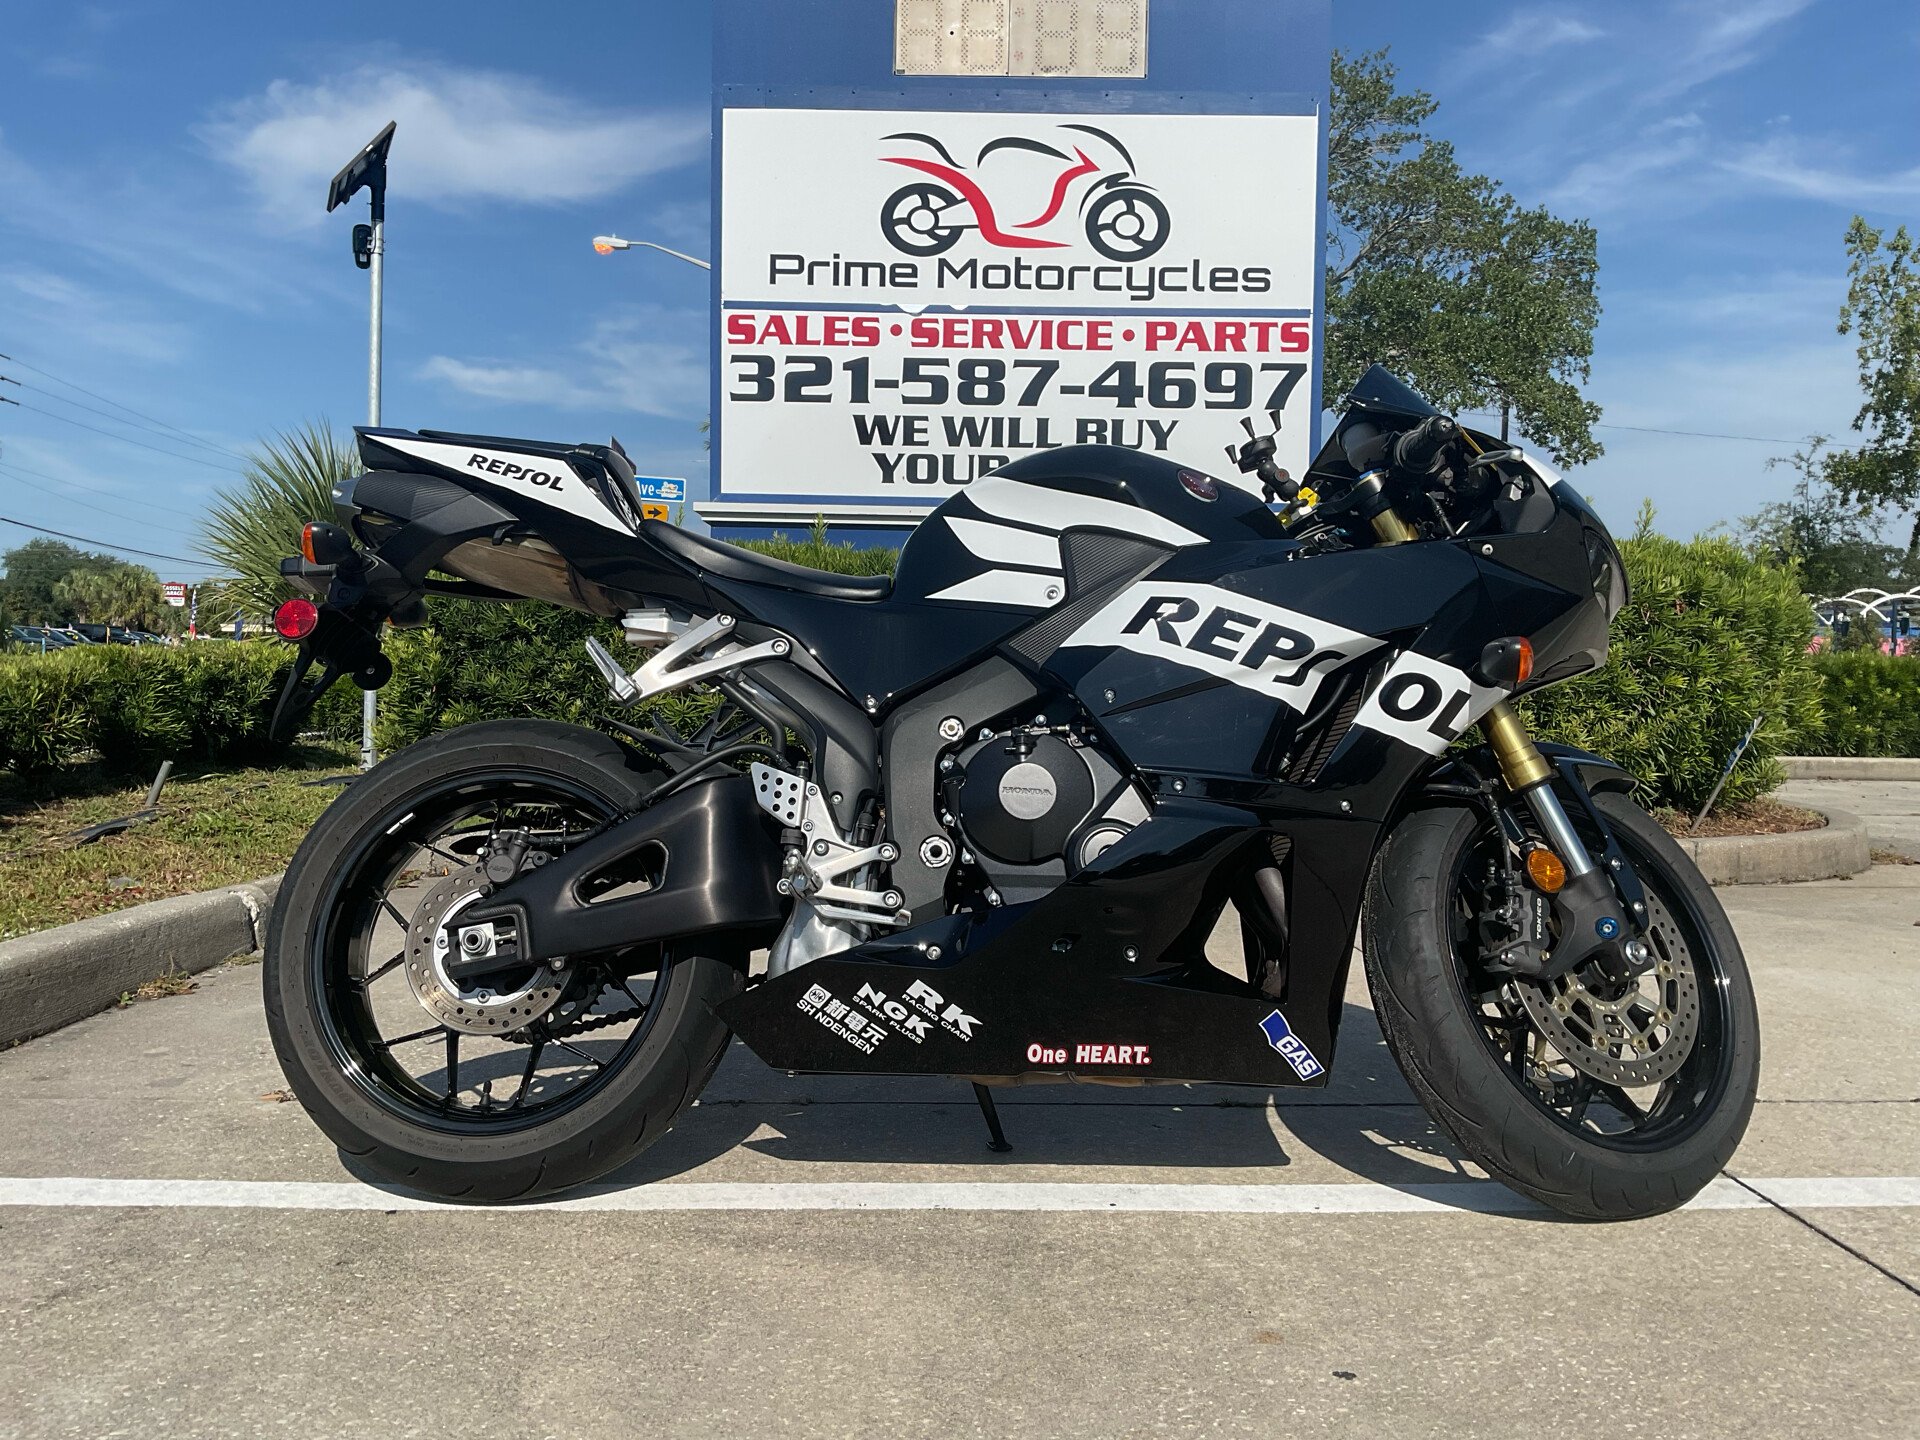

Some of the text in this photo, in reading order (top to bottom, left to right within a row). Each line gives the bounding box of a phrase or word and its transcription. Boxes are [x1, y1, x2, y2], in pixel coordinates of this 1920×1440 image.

[769, 253, 1272, 301] Prime Motorcycles
[727, 314, 1310, 353] SALES SERVICE PARTS
[729, 354, 1309, 412] 321-587-4697
[852, 414, 1179, 451] WE WILL BUY
[466, 453, 564, 492] REPSOL
[1120, 595, 1472, 742] REPSOL
[1001, 785, 1053, 797] HONDA
[852, 994, 924, 1044] SPARK PLUGS
[856, 982, 934, 1039] NGK
[901, 993, 970, 1043] RACING CHAIN
[904, 979, 984, 1037] RK
[1027, 1043, 1151, 1065] One HEART.
[1275, 1035, 1318, 1077] GAS
